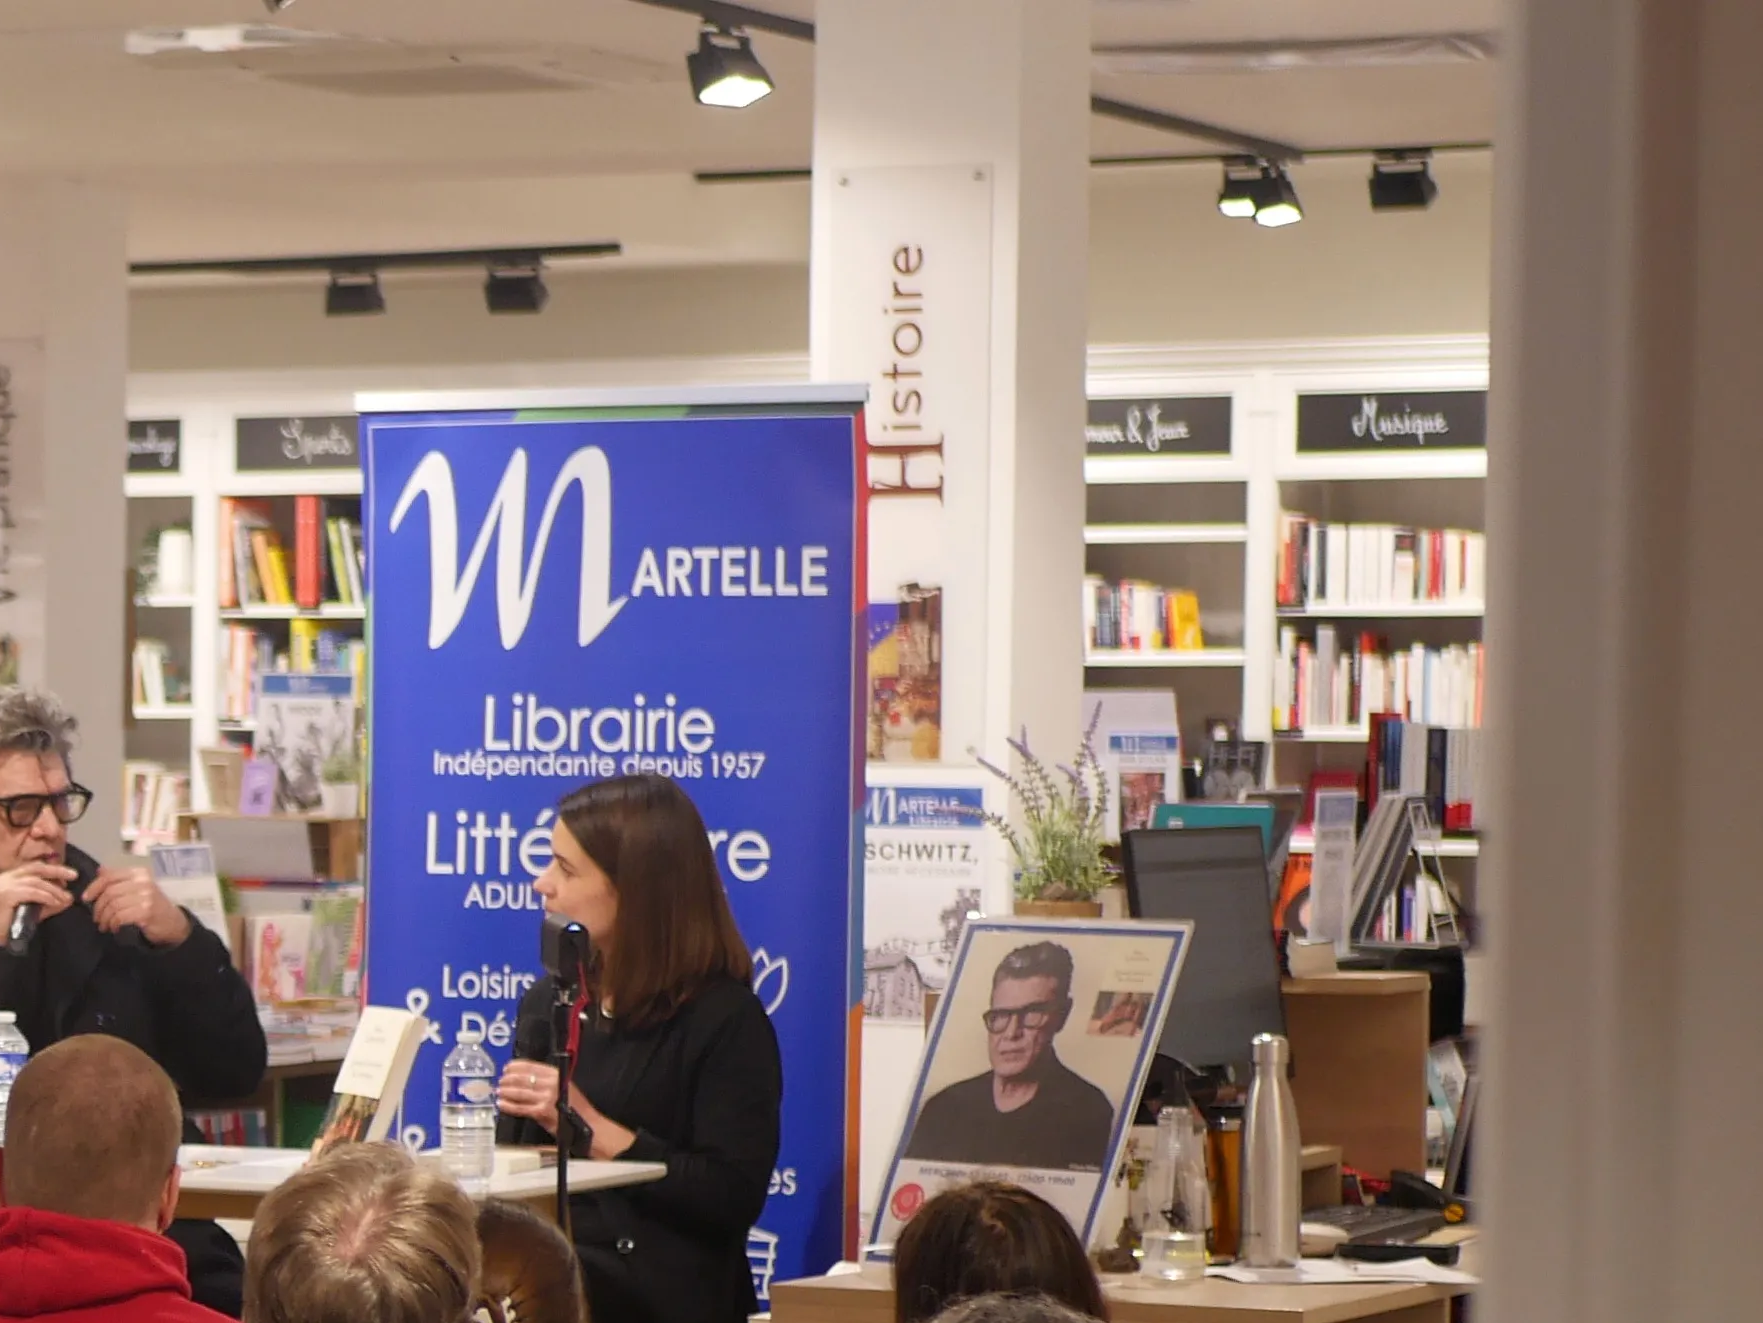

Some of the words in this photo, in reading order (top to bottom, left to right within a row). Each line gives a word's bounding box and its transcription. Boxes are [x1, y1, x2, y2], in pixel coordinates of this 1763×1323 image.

[866, 244, 944, 508] Histoire
[279, 417, 353, 465] Sports
[1350, 396, 1450, 445] Musique
[388, 445, 828, 651] MARTELLE
[484, 693, 716, 753] Librairie
[433, 749, 615, 781] Indépendante
[621, 751, 703, 778] depuis
[711, 752, 766, 779] 1957
[426, 808, 772, 882] Littére
[864, 843, 979, 865] SCHWITZ,
[464, 882, 546, 910] ADUL
